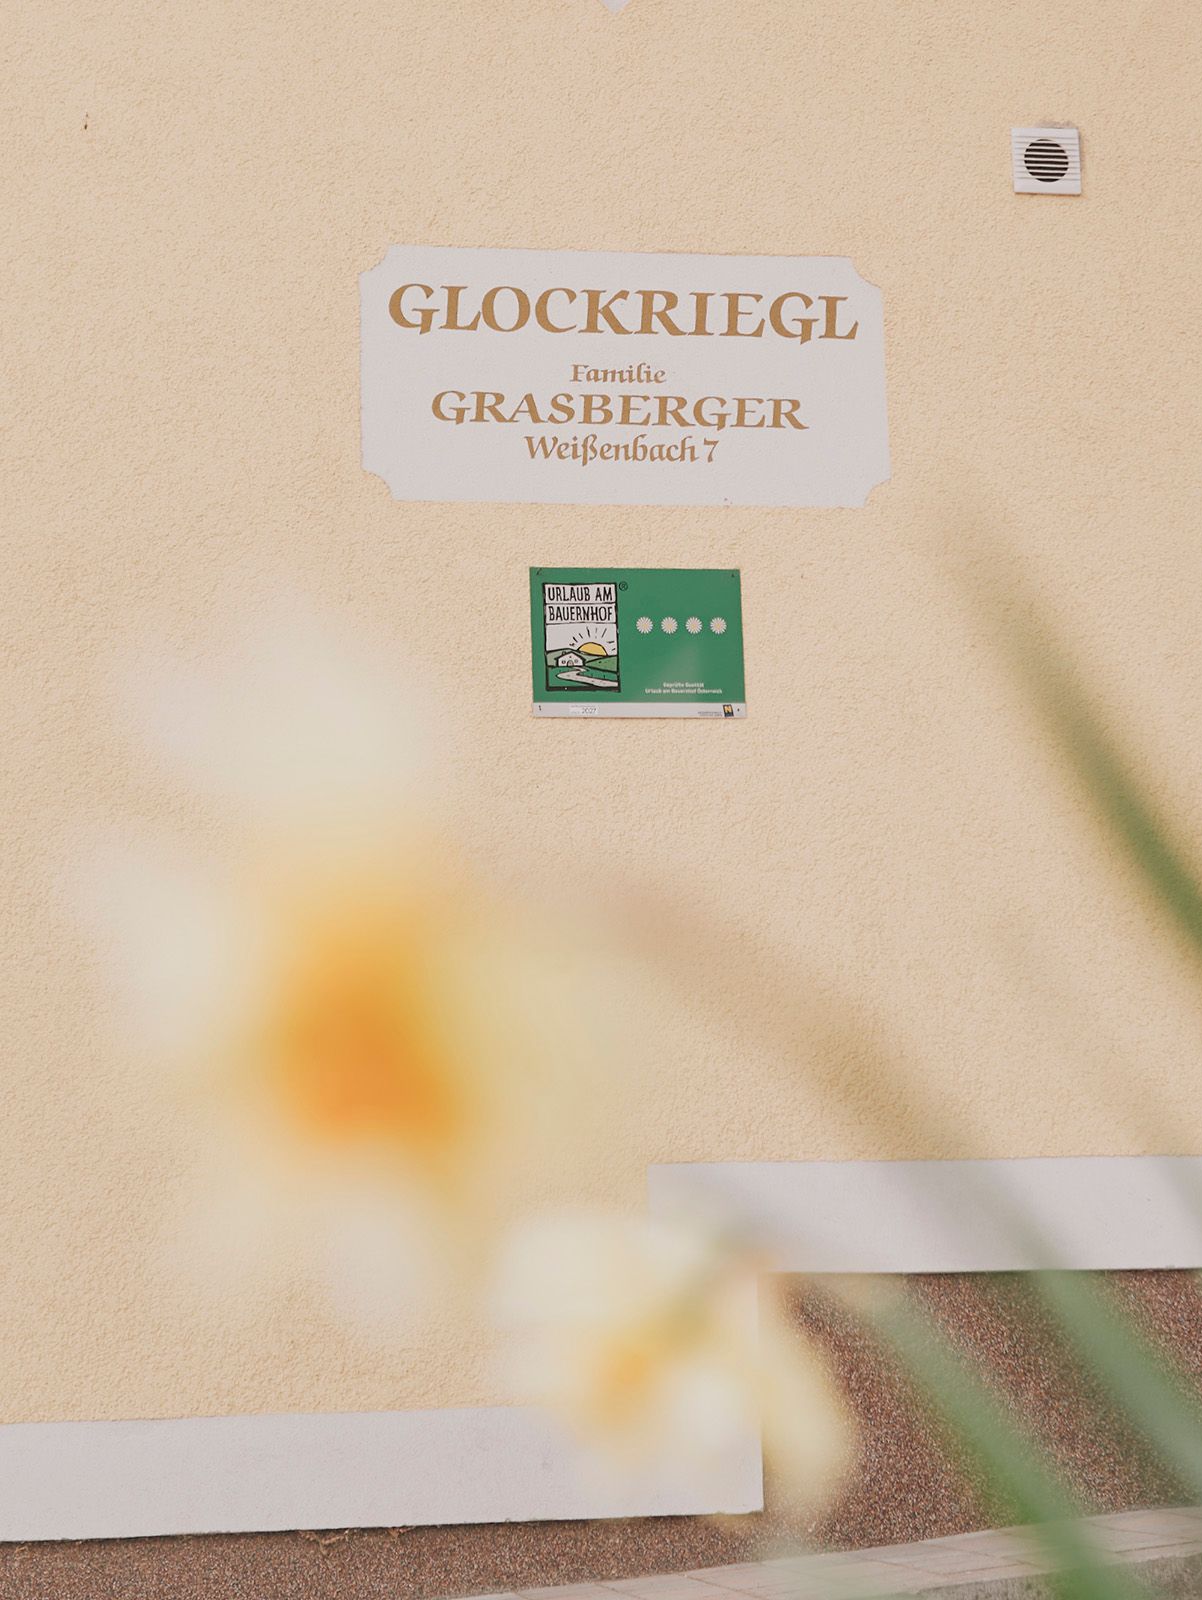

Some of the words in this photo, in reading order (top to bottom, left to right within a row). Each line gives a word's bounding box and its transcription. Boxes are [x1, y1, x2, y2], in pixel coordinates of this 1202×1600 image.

[389, 283, 859, 344] GLOCKRIEGL
[570, 362, 666, 384] Familie
[431, 390, 809, 431] GRASBERGER
[524, 434, 699, 466] Weißenbach
[703, 438, 719, 463] 7
[548, 587, 591, 601] URLAUB
[595, 587, 613, 601] AM
[549, 606, 613, 621] BAUERNHOF
